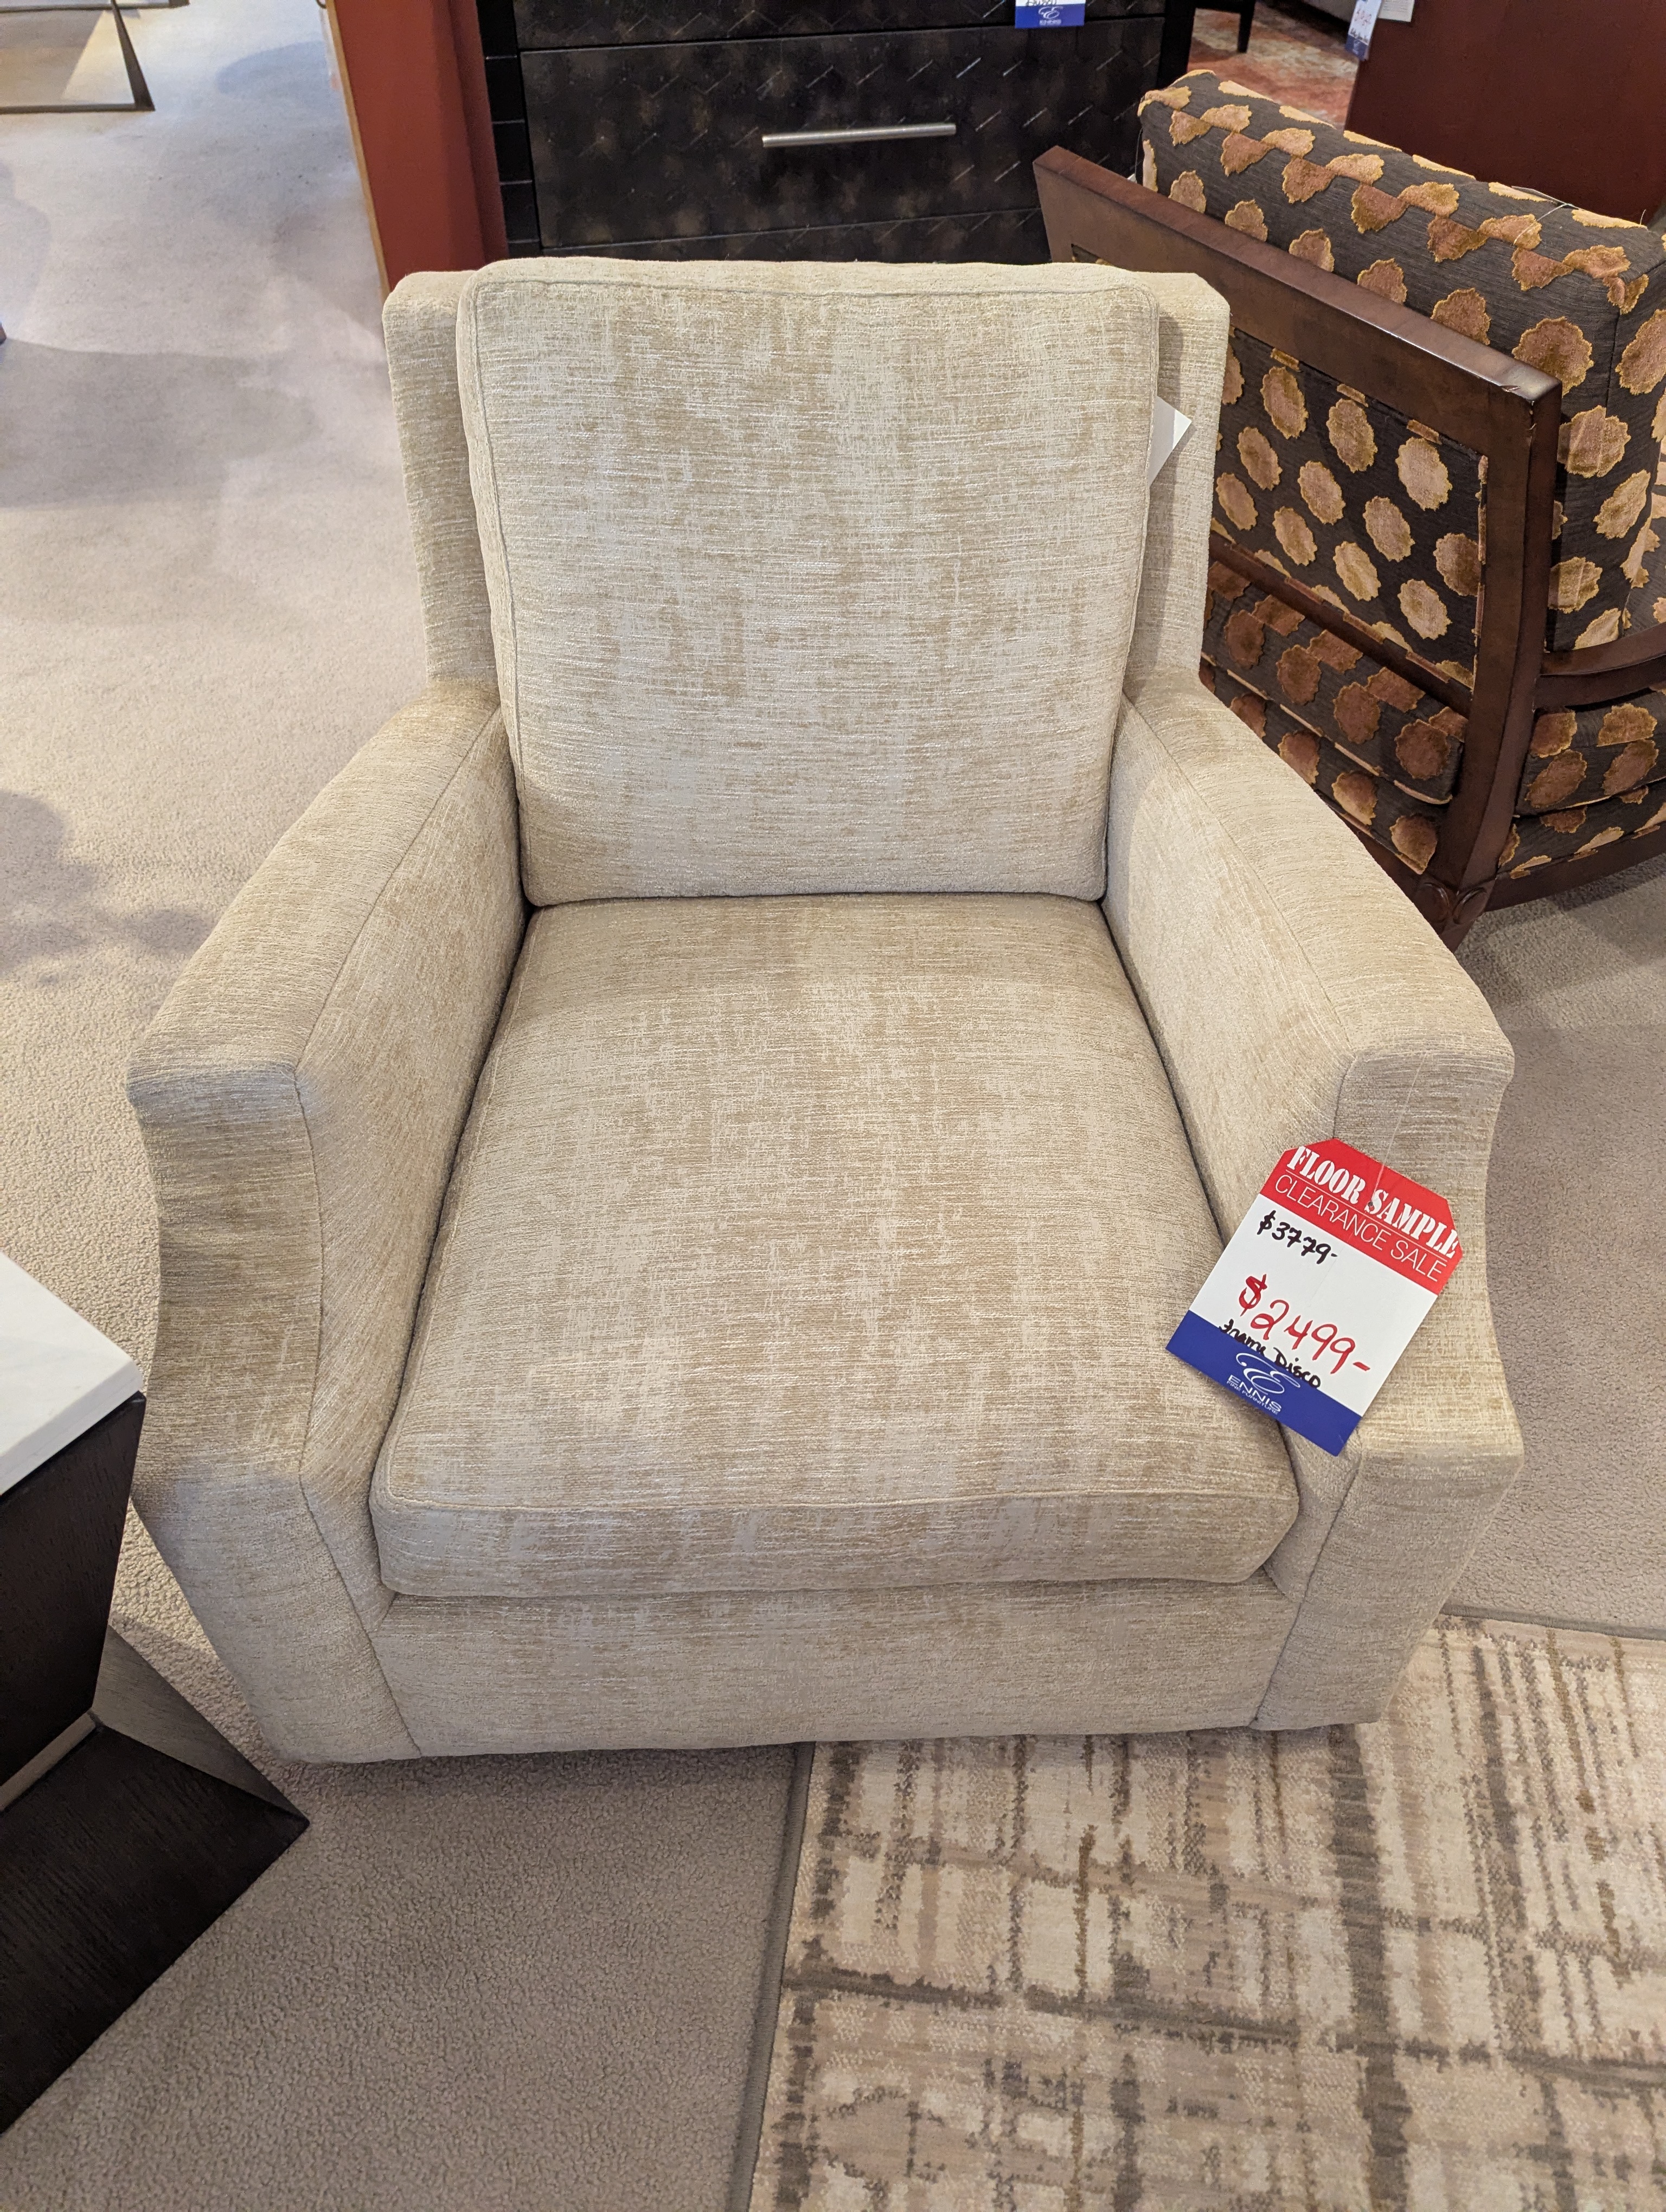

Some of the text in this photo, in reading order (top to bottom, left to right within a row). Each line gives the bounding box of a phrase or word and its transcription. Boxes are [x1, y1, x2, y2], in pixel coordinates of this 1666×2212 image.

[1275, 1174, 1447, 1282] CLEARANCE SALE
[1286, 1146, 1459, 1259] FLOOR SAMPLE
[1226, 1380, 1279, 1415] FINE FURNITURE
[1228, 1374, 1282, 1412] ENNIS
